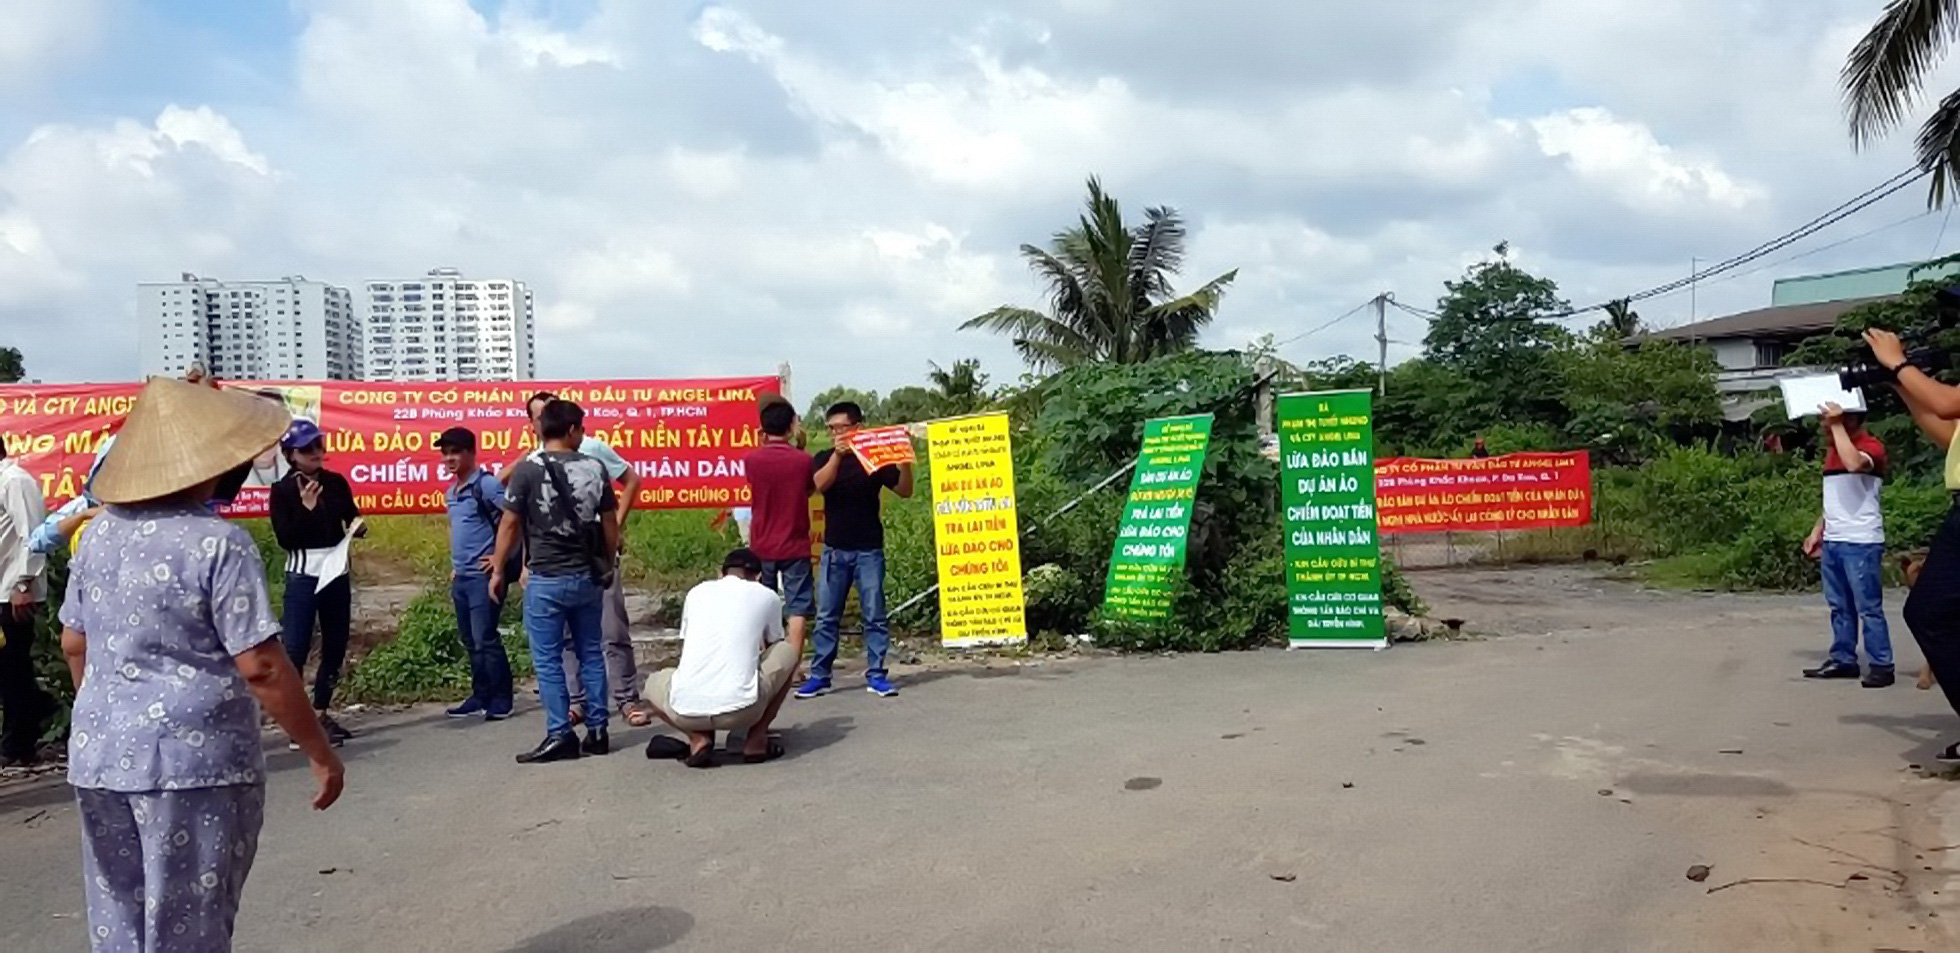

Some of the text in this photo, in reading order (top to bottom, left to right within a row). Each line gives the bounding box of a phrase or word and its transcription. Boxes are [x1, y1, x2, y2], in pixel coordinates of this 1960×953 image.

[43, 396, 80, 415] CTY
[402, 390, 423, 405] TY
[657, 388, 714, 402] ANGEL
[717, 388, 757, 401] LINA
[325, 426, 367, 453] LỪA
[373, 424, 423, 452] ĐẢO
[481, 427, 512, 456] DỰ
[686, 424, 723, 449] TÂY
[1312, 447, 1340, 468] ĐẢO
[1342, 447, 1368, 467] BÁN
[350, 456, 429, 483] CHIẾM
[697, 455, 746, 478] DÂN
[39, 466, 88, 499] TÂ
[640, 485, 675, 504] GIÚP
[678, 484, 731, 504] CHÚNG
[733, 484, 752, 504] TÔ
